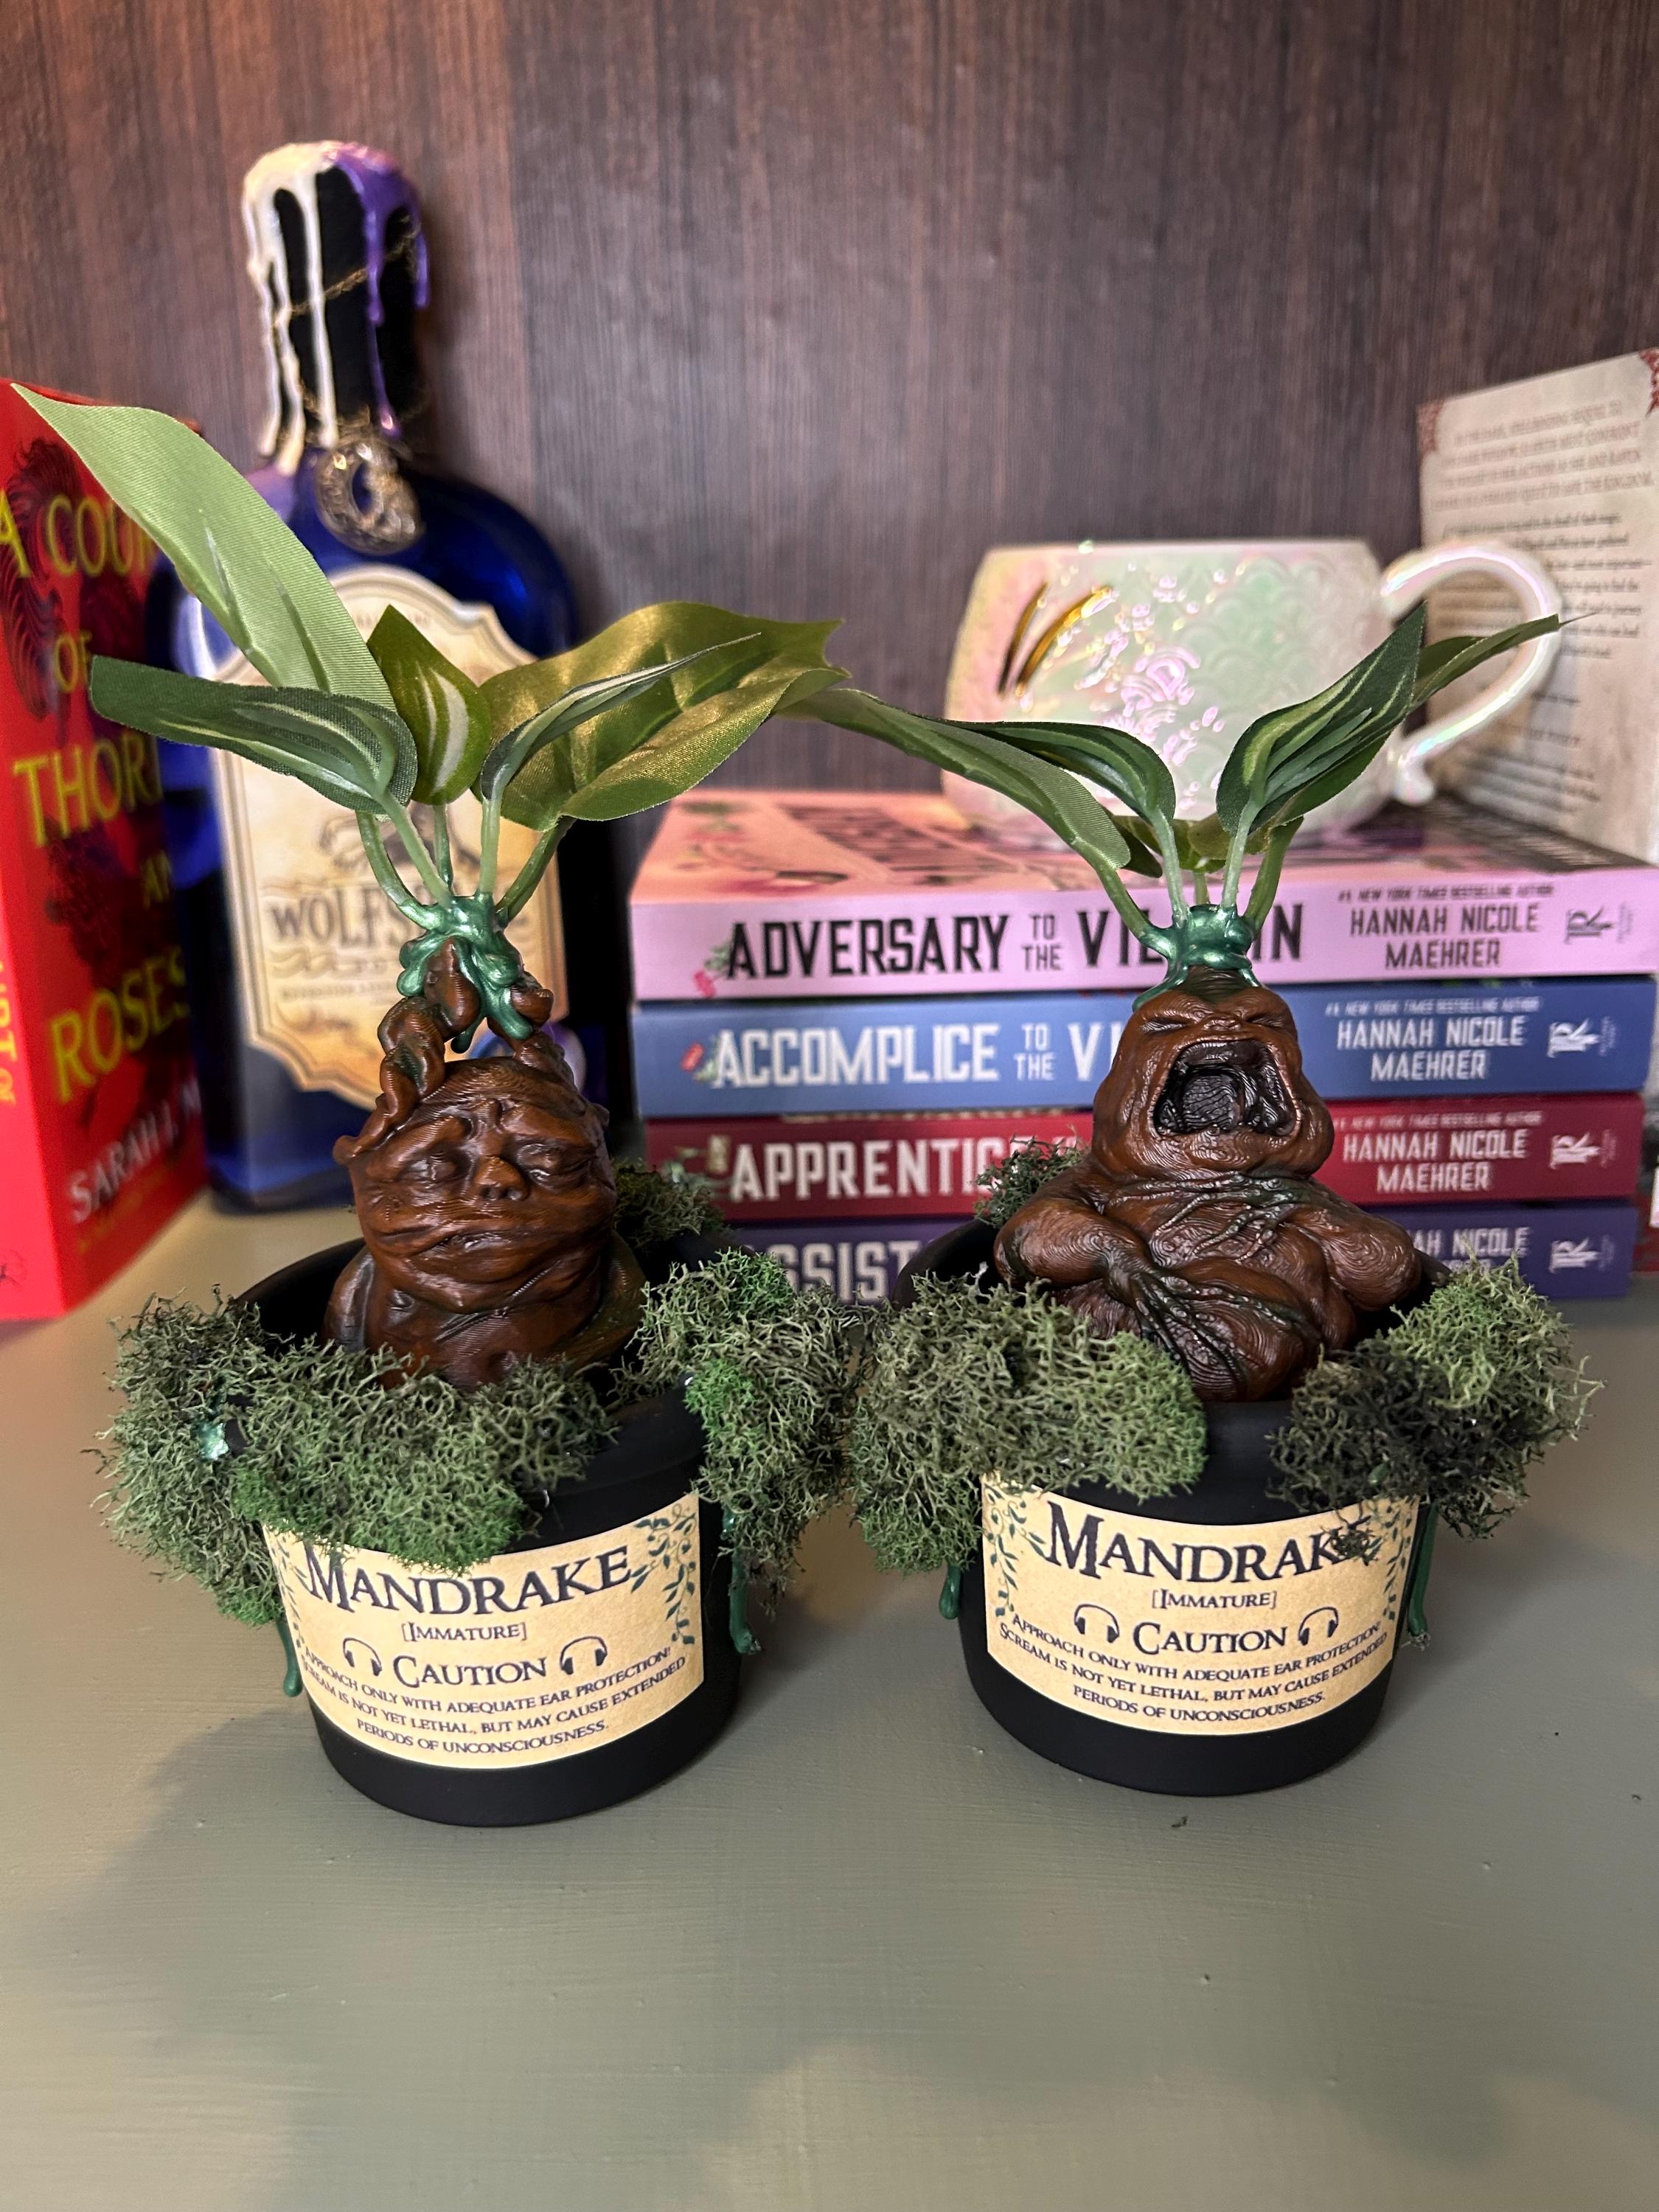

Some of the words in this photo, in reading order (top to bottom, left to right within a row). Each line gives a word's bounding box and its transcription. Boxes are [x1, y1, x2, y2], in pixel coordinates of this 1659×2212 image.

[1029, 914, 1057, 942] TO
[1350, 905, 1448, 938] HANNAH
[1461, 902, 1542, 935] NICOLE
[726, 914, 1010, 980] ADVERSARY
[1021, 945, 1063, 972] THE
[1385, 939, 1501, 970] MAEHRER
[1022, 1023, 1049, 1051] TO
[1336, 1017, 1435, 1051] HANNAH
[1445, 1015, 1528, 1048] NICOLE
[711, 1023, 1001, 1088] ACCOMPLICE
[1014, 1054, 1056, 1081] THE
[1370, 1049, 1489, 1082] MAEHRER
[1342, 1132, 1439, 1164] HANNAH
[1450, 1128, 1531, 1161] NICOLE
[729, 1135, 1026, 1203] APPRENTIC
[1375, 1161, 1492, 1194] MAEHRER
[1452, 1226, 1534, 1259] NICOLE
[1045, 1500, 1372, 1584] MANDRAK
[303, 1543, 633, 1615] MANDRAKE
[1152, 1588, 1278, 1610] [IMMATURE]
[401, 1621, 528, 1642] [IMMATURE]
[1012, 1613, 1084, 1658] APPROACH
[1088, 1651, 1131, 1671] ONLY
[1135, 1663, 1177, 1679] WITH
[1183, 1667, 1270, 1683] ADEQUATE
[1274, 1660, 1301, 1675] EAR
[1133, 1621, 1288, 1655] CAUTION
[305, 1646, 358, 1691] APPROACH
[361, 1684, 397, 1704] ONLY
[400, 1695, 442, 1711] WITH
[447, 1699, 535, 1714] ADEQUATE
[540, 1689, 572, 1705] EAR
[577, 1646, 672, 1697] PROTECTION!
[393, 1655, 547, 1688] CAUTION
[1000, 1622, 1051, 1664] SCREAM
[1055, 1658, 1068, 1671] IS
[1072, 1663, 1104, 1684] NOT
[1107, 1676, 1136, 1693] YET
[1141, 1684, 1208, 1703] LETHAL,
[1214, 1689, 1245, 1701] BUT
[1248, 1684, 1281, 1700] MAY
[1284, 1669, 1329, 1693] CAUSE
[1332, 1632, 1388, 1677] EXTENDED
[338, 1689, 349, 1704] IS
[352, 1697, 379, 1717] NOT
[380, 1709, 407, 1726] YET
[411, 1717, 477, 1734] LETHAL,
[481, 1720, 513, 1733] BUT
[518, 1714, 552, 1731] MAY
[556, 1698, 608, 1722] CAUSE
[612, 1656, 686, 1706] EXTENDED
[1074, 1684, 1138, 1714] PERIODS
[1143, 1705, 1166, 1717] OF
[1170, 1691, 1326, 1722] UNCONSCIOUSNESS.
[356, 1718, 414, 1747] PERIODS
[417, 1738, 440, 1750] OF
[442, 1719, 609, 1753] UNCONSCIOUSNESS.
